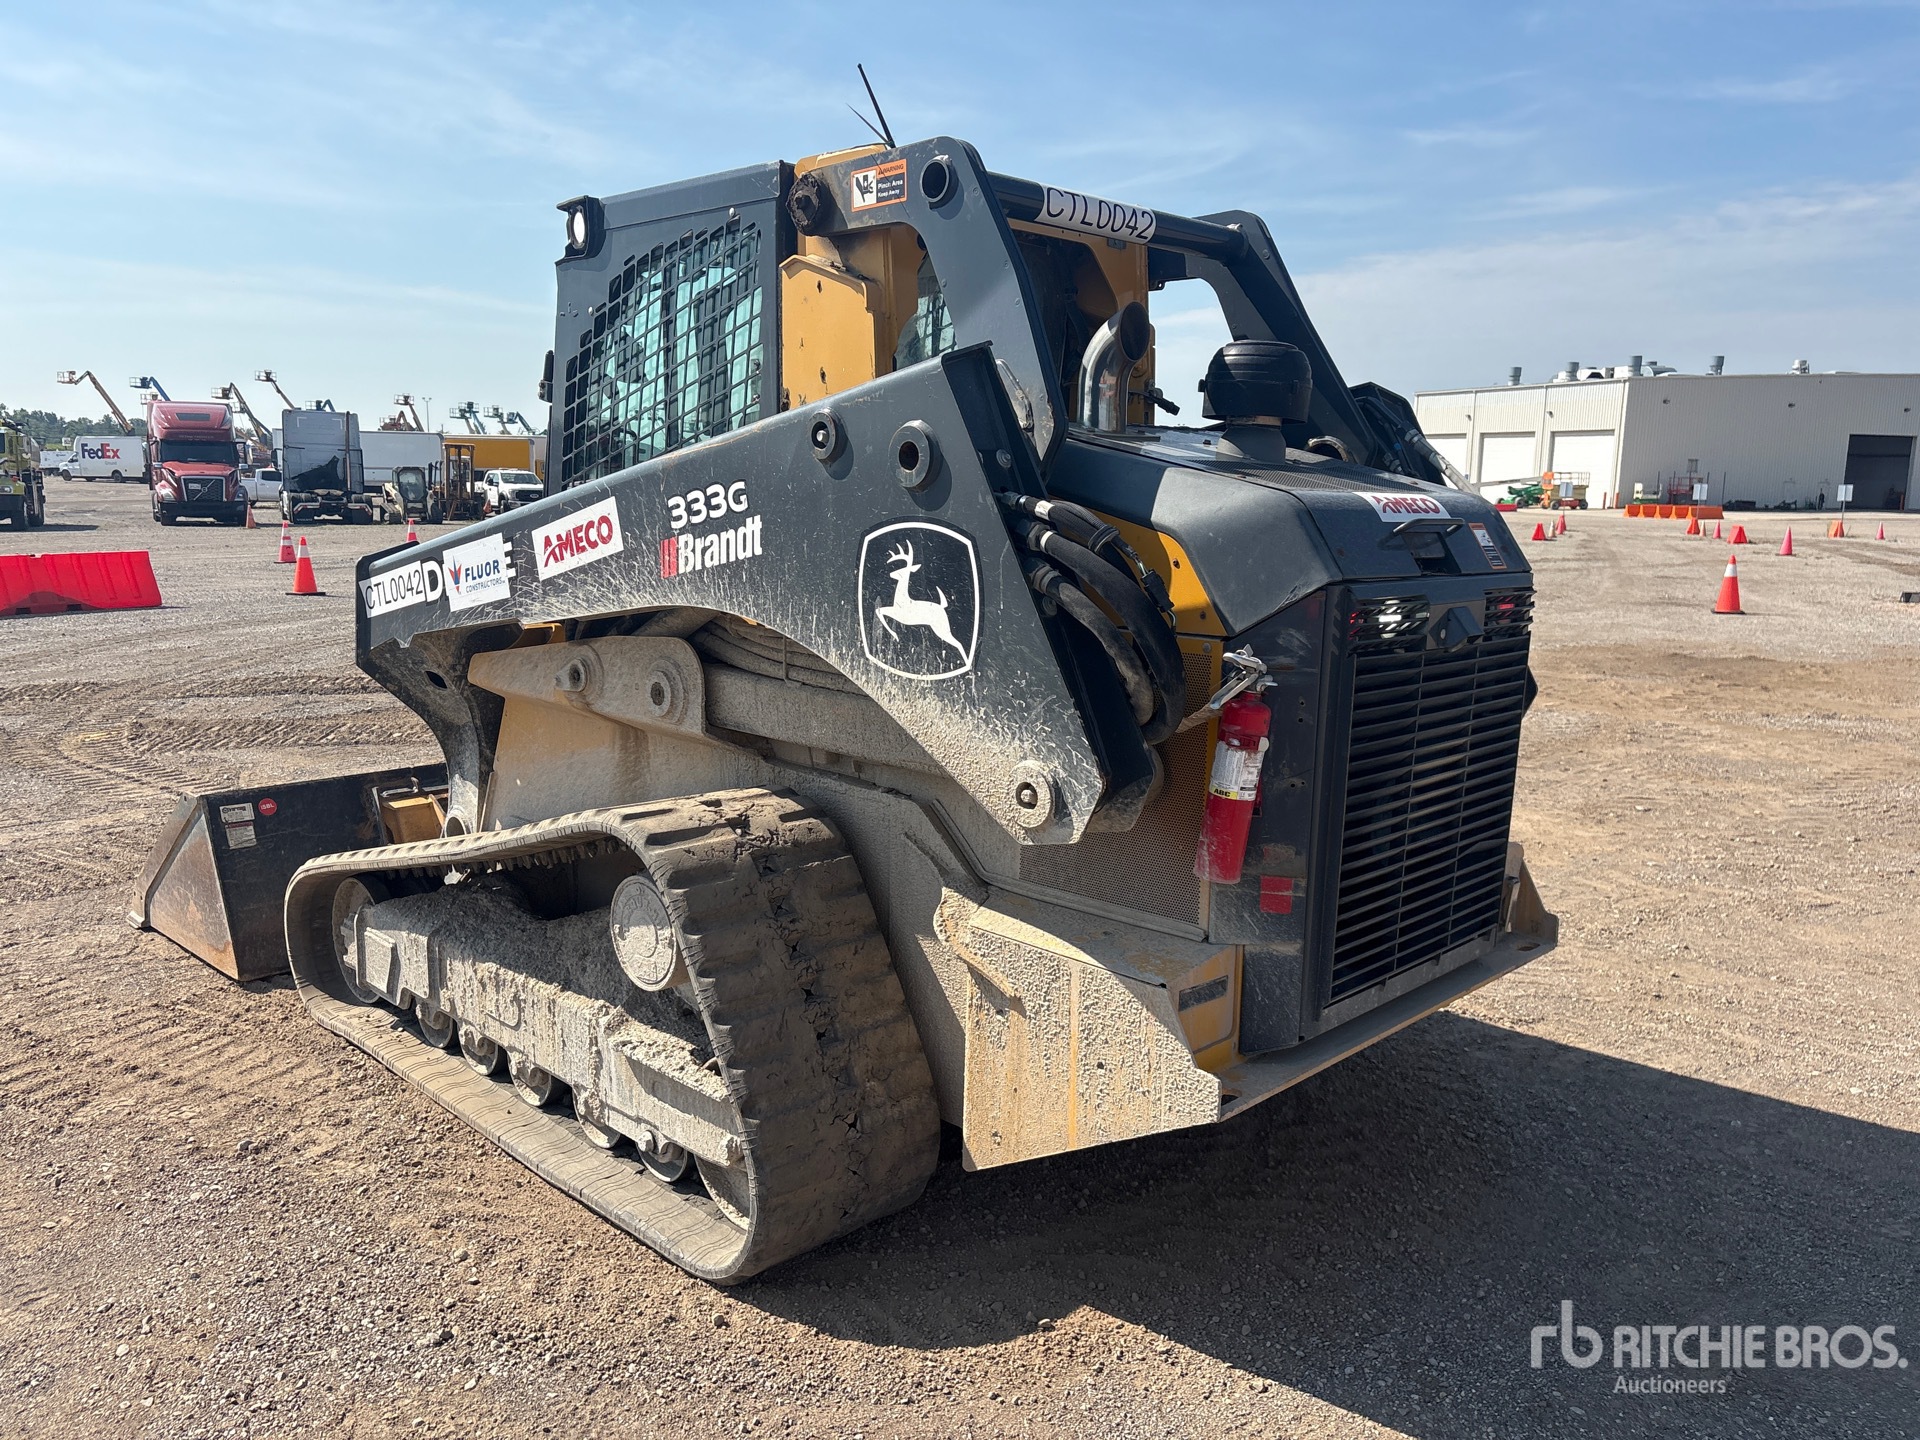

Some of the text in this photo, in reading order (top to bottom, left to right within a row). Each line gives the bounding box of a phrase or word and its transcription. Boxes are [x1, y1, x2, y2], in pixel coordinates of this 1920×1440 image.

[883, 163, 904, 174] WARNING
[877, 179, 903, 190] Pinch Area
[1046, 187, 1154, 240] CTL0042
[81, 442, 121, 459] FedEx
[667, 480, 749, 530] 333G
[1371, 495, 1441, 514] AMECO
[543, 514, 613, 568] AMECO
[677, 514, 763, 574] Brandt
[464, 559, 500, 583] FLUOR
[364, 569, 424, 610] CTL0042
[466, 576, 502, 593] CONSTRUCTORS
[1213, 788, 1231, 797] ABC
